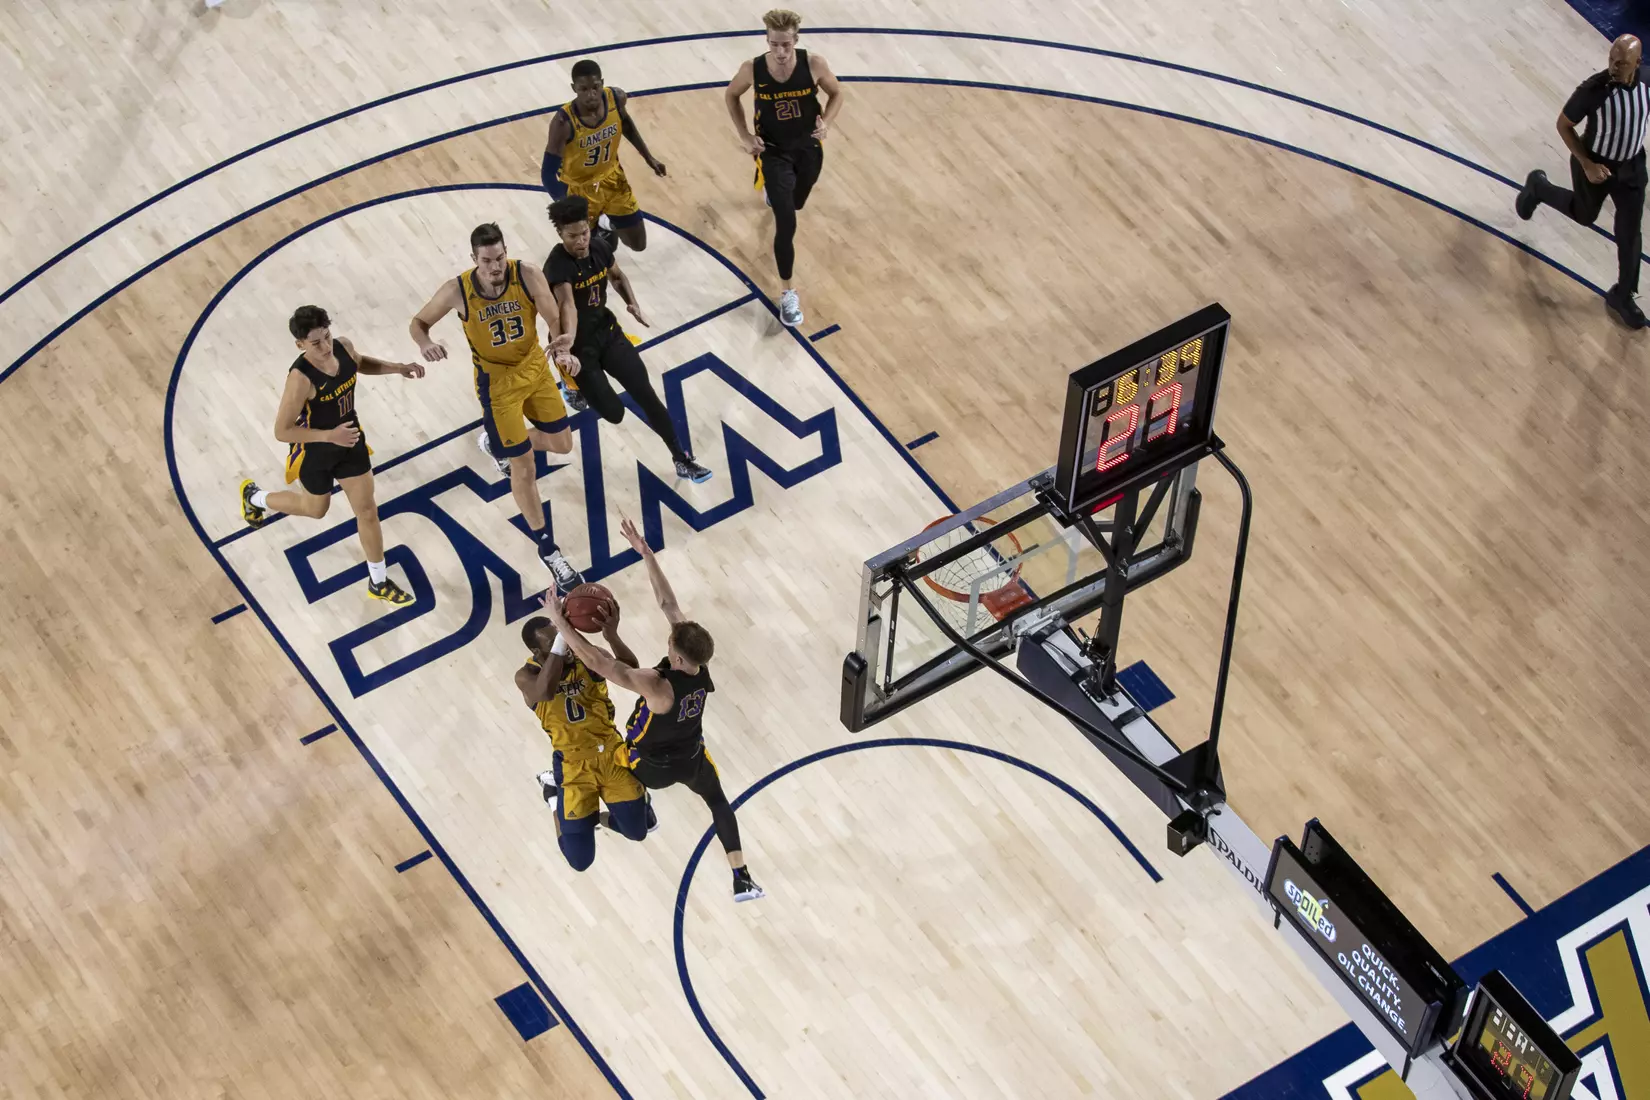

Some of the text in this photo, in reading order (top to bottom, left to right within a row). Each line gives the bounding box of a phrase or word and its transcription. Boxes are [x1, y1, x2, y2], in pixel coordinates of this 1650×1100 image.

[759, 93, 772, 101] CAL
[775, 99, 802, 120] 21
[584, 140, 611, 167] 31
[488, 315, 525, 347] 33
[320, 393, 333, 401] CAL
[338, 390, 353, 418] 11
[1096, 382, 1183, 472] 27
[565, 696, 587, 723] 0
[677, 687, 707, 722] 13
[1287, 883, 1335, 939] spOILed
[1351, 950, 1402, 1011] QUALITY.
[1361, 943, 1401, 991] QUICK.
[1337, 952, 1408, 1034] OIL CHANGE.
